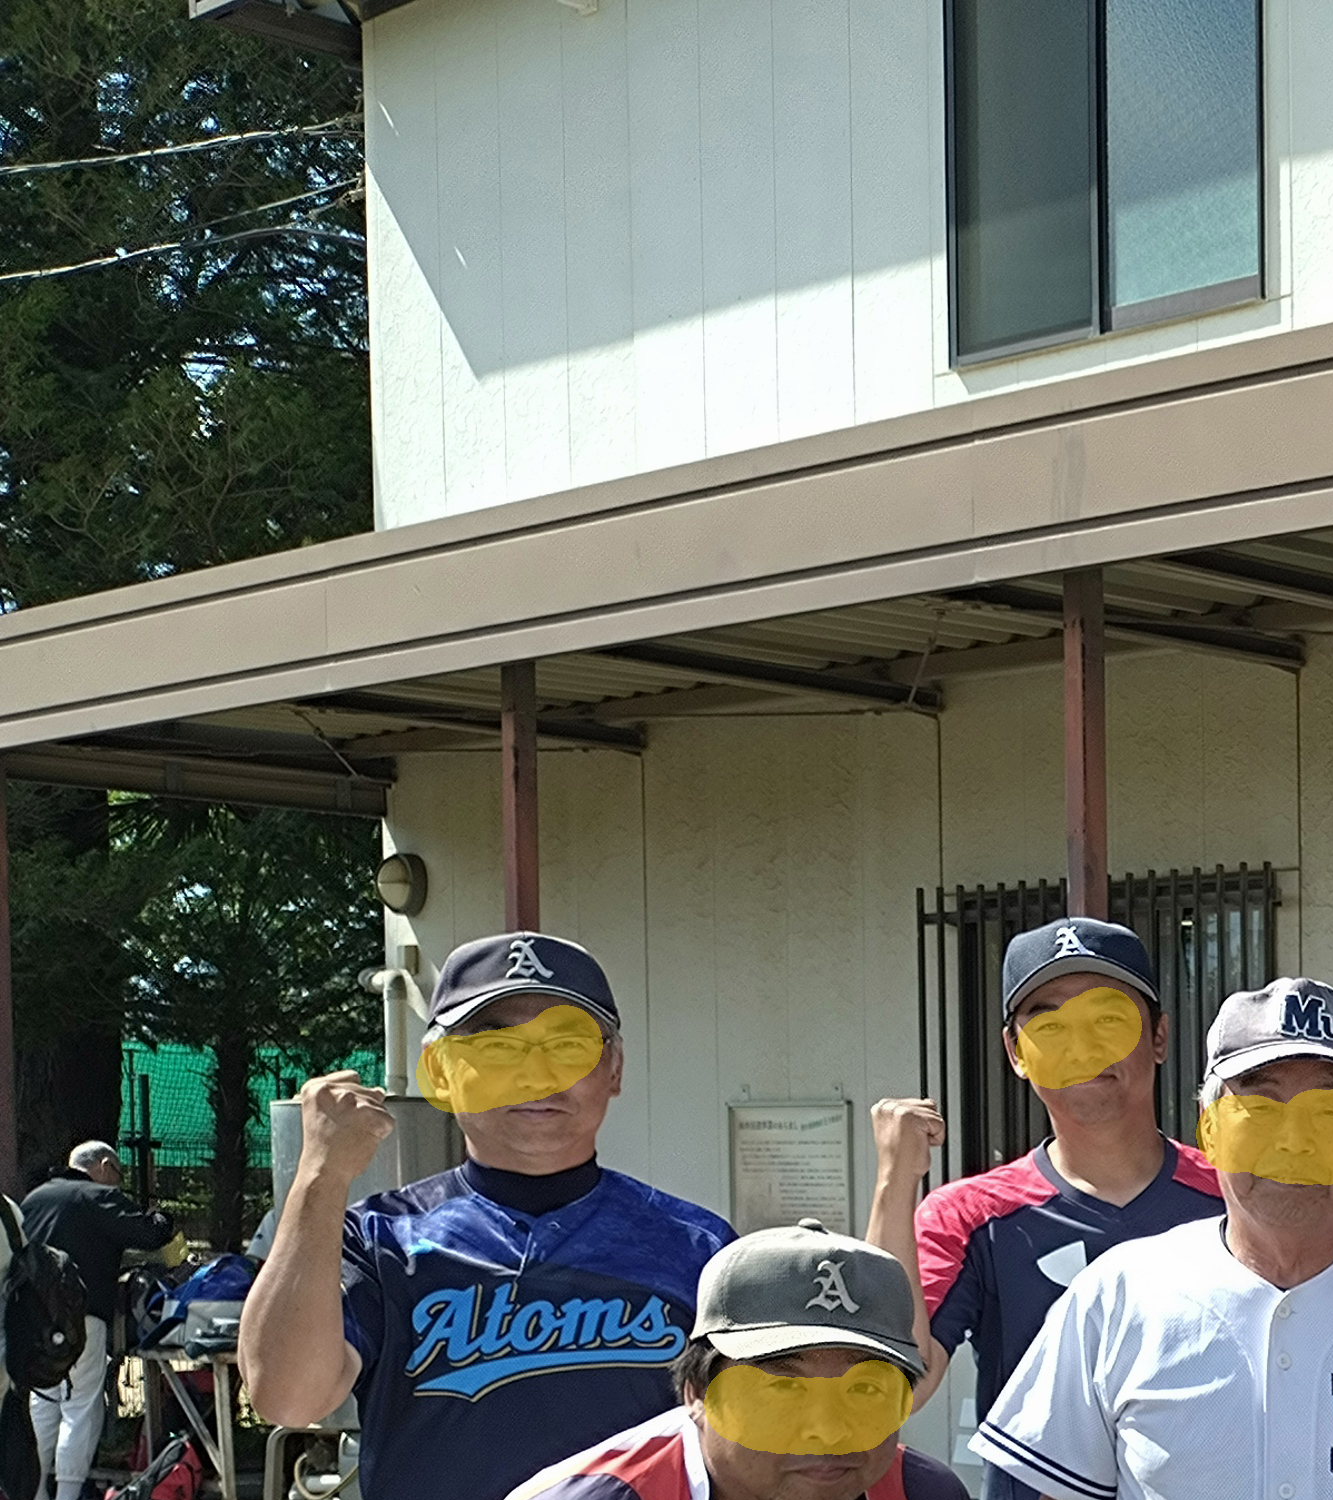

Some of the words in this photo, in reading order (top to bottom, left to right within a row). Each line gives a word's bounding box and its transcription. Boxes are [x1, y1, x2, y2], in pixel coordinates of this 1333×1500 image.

[506, 939, 554, 980] A
[1055, 926, 1095, 957] A
[806, 1259, 860, 1314] A
[405, 1281, 685, 1379] Atoms
